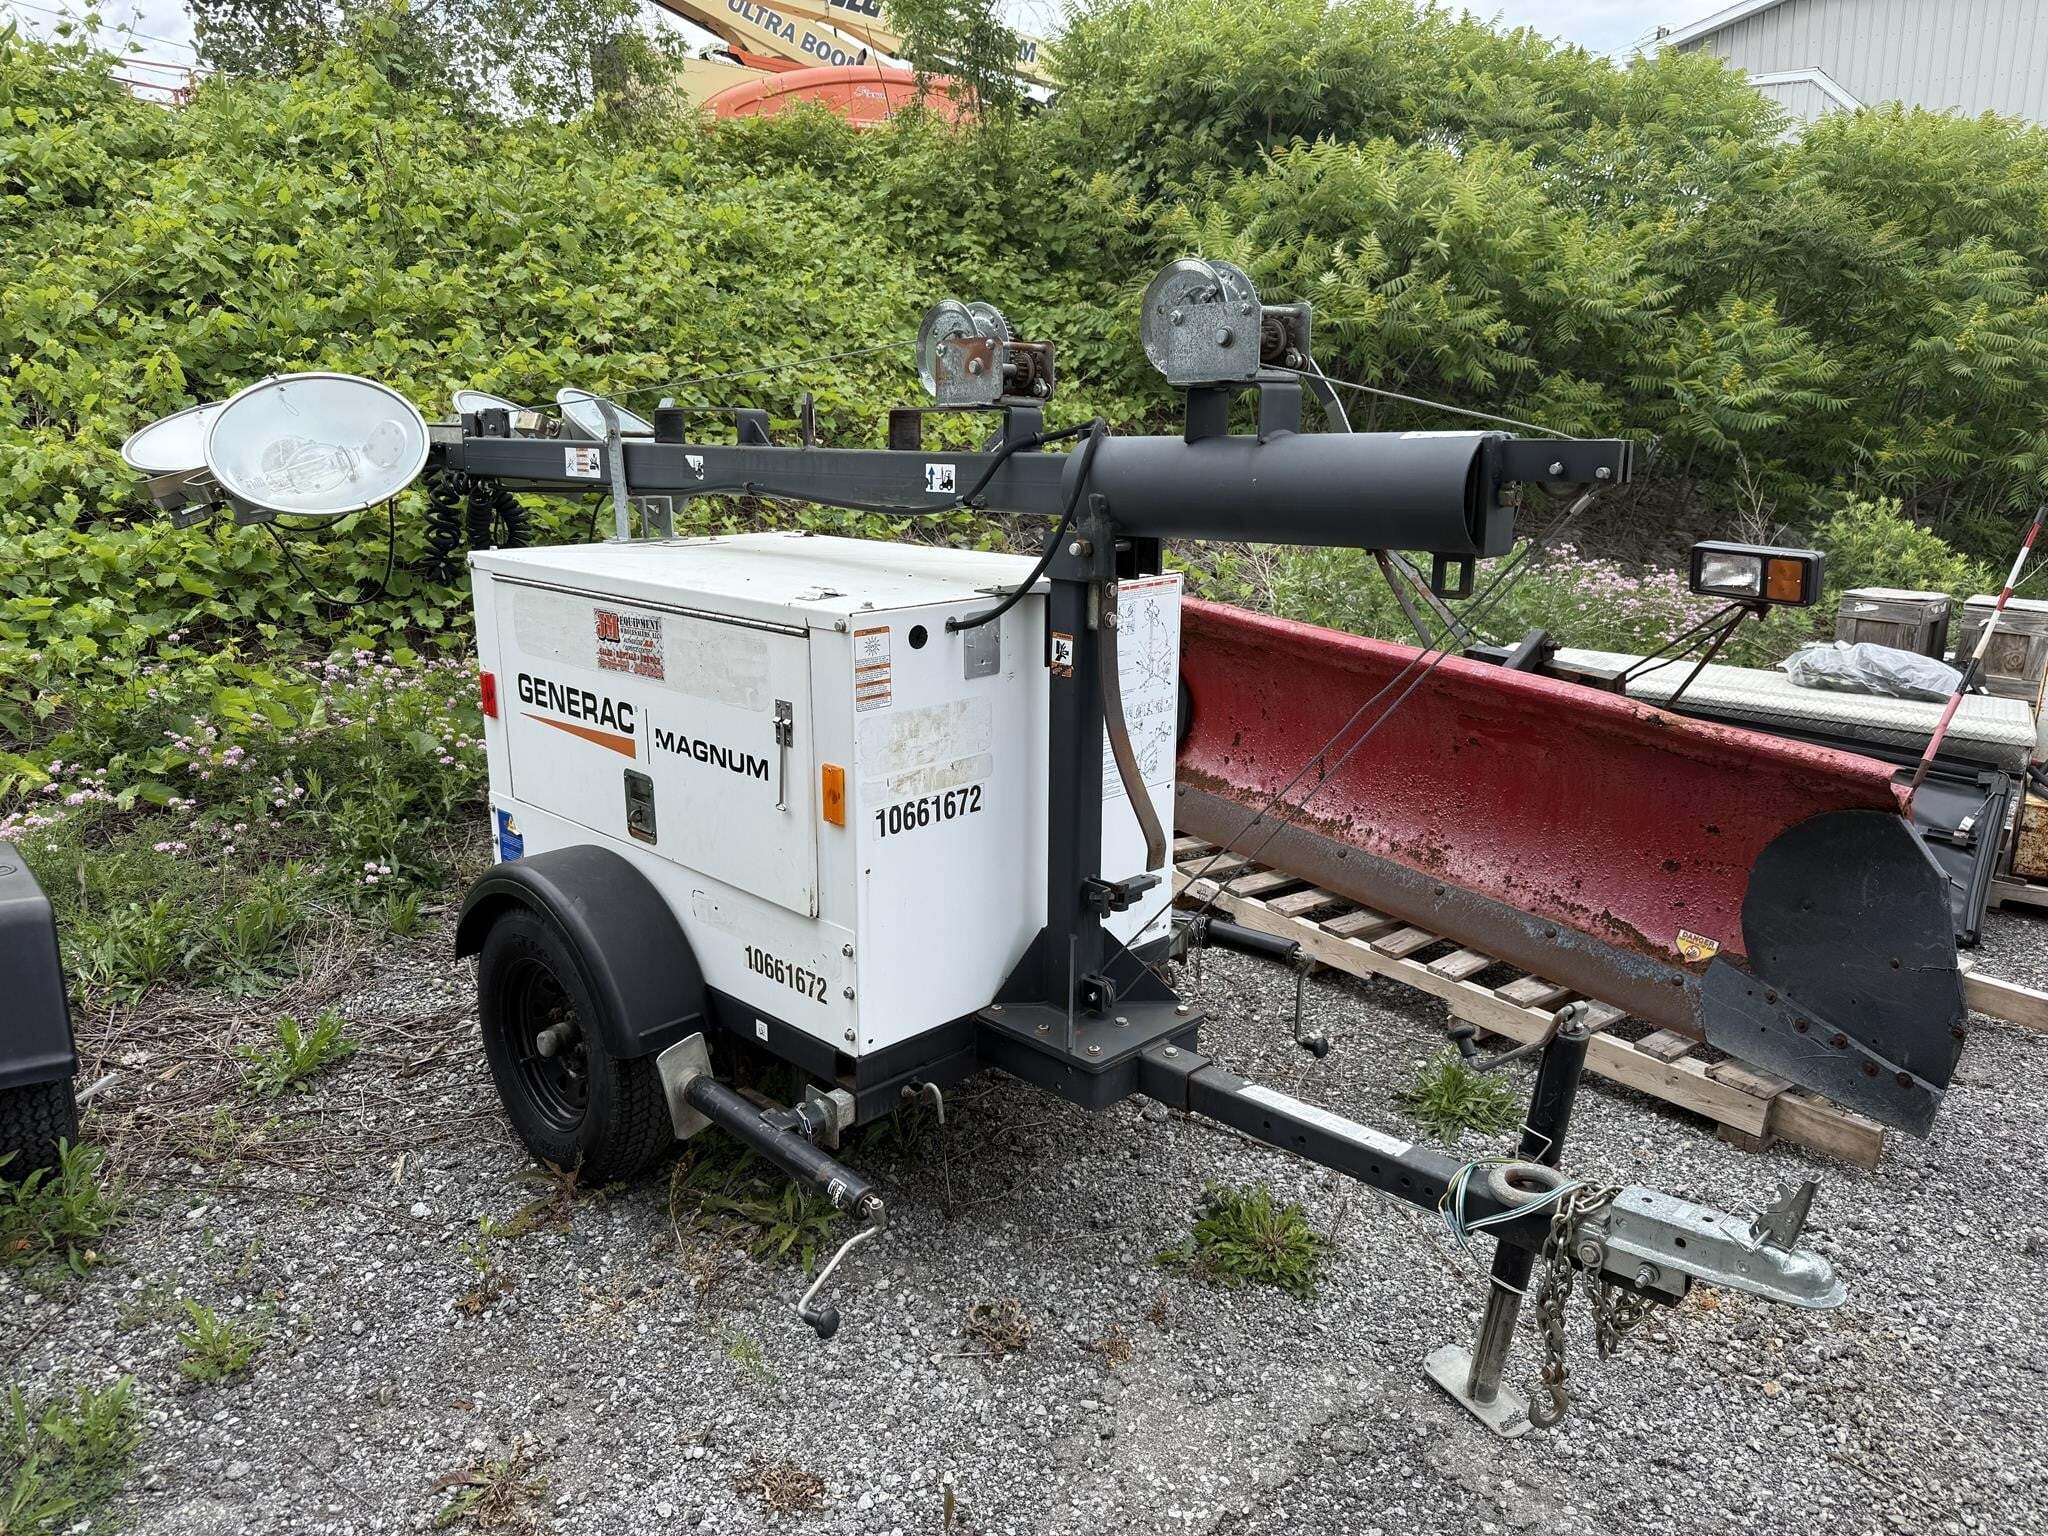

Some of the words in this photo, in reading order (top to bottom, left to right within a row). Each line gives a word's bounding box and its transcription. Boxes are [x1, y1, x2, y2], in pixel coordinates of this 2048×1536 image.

[727, 0, 796, 44] ULTRA
[620, 615, 660, 631] EQUIPMENT
[517, 672, 635, 734] GENERAC
[655, 728, 769, 781] MAGNUM
[875, 784, 982, 838] 10661672
[1681, 931, 1716, 948] DANGER
[744, 945, 828, 1005] 10661672
